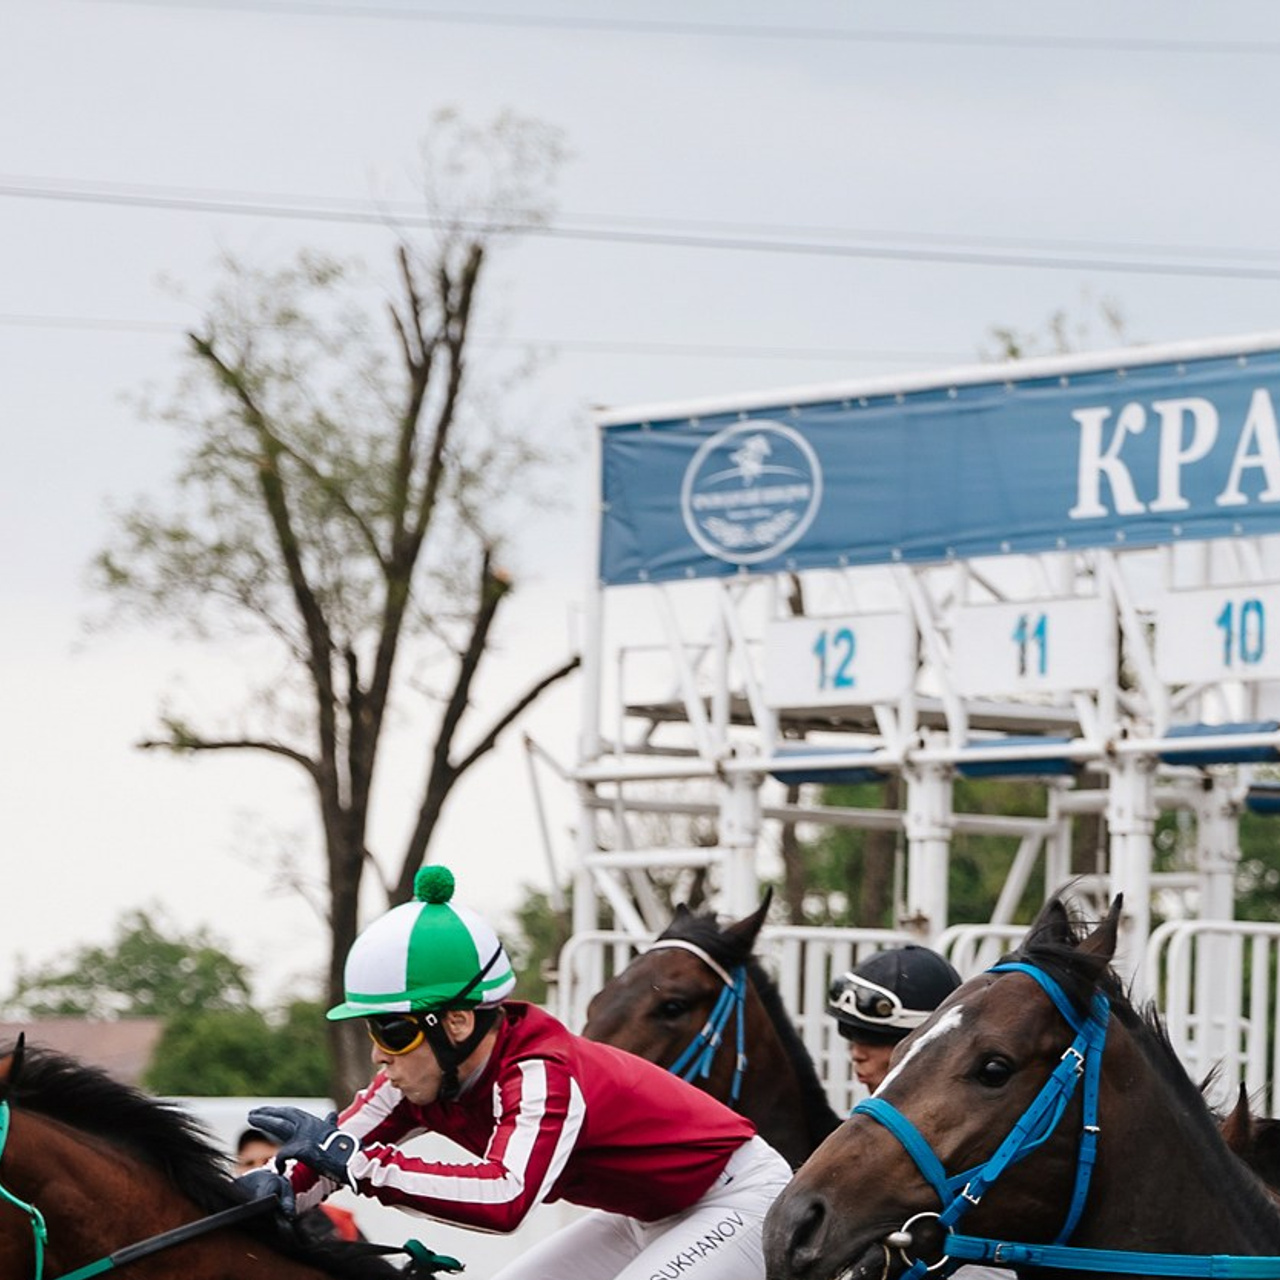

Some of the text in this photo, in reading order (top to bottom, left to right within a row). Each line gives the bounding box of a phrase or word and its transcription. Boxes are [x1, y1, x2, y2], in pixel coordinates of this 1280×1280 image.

[812, 628, 857, 691] 12
[1012, 612, 1049, 678] 11
[1215, 598, 1266, 665] 10
